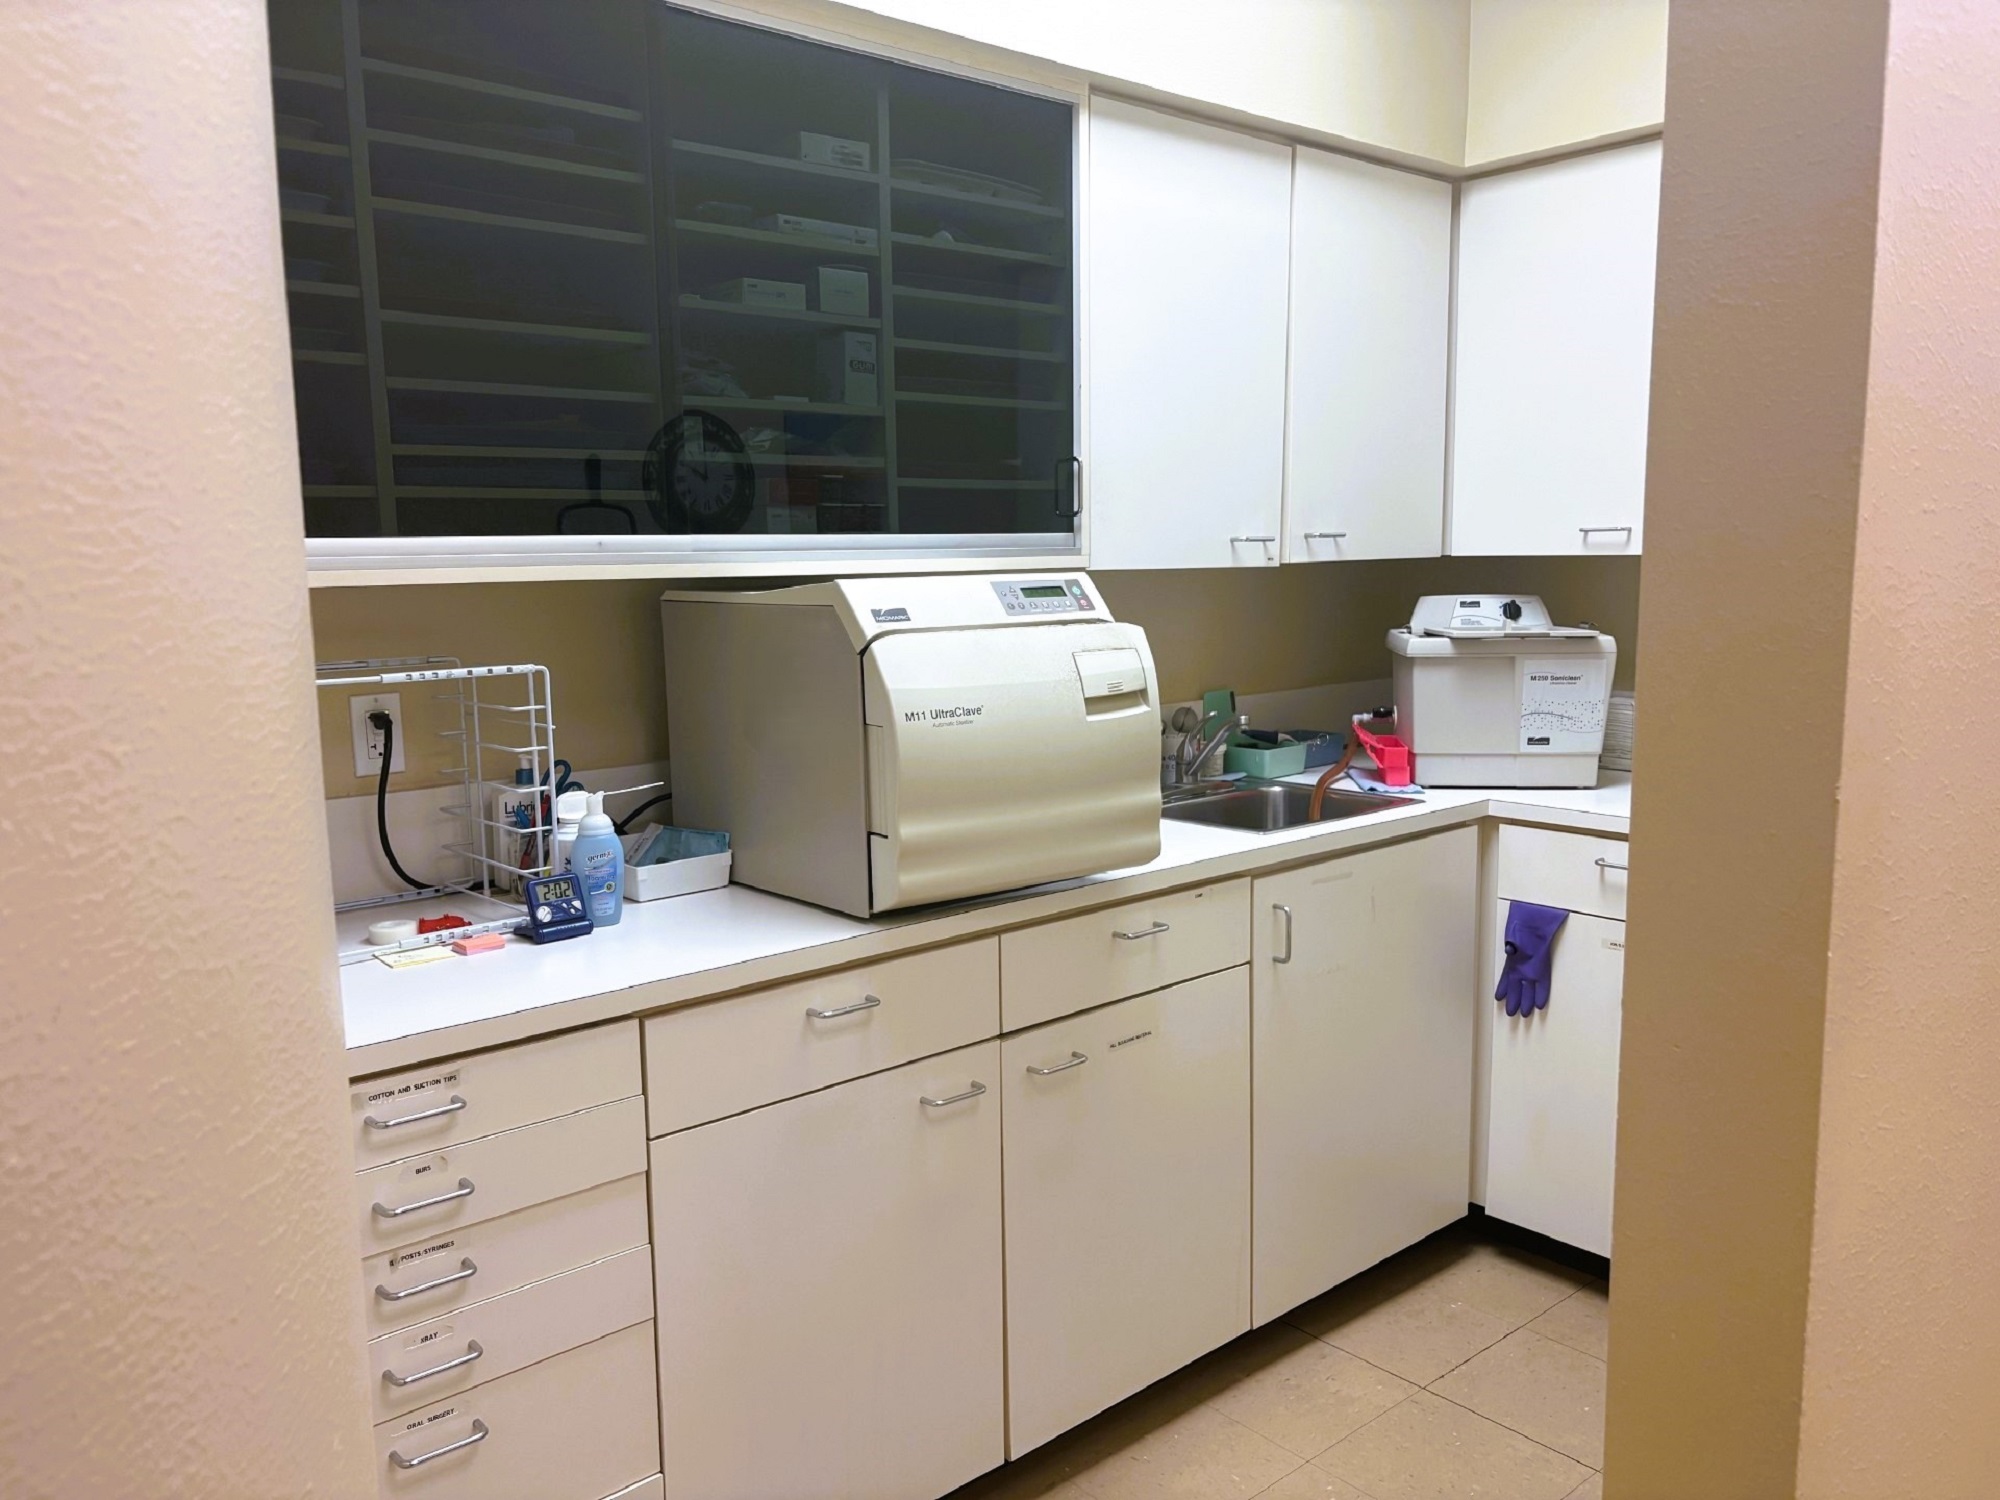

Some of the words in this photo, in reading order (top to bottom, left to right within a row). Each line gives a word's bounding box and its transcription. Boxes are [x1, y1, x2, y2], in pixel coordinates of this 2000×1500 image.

[905, 711, 927, 722] M11
[930, 706, 982, 721] UltraClave
[543, 881, 571, 901] 2:02
[368, 1089, 395, 1102] COTTON
[397, 1085, 411, 1095] AND
[414, 1078, 442, 1091] SUCTION
[443, 1075, 457, 1083] TIPS
[415, 1165, 432, 1175] BURS
[406, 1420, 424, 1430] ORAL
[427, 1408, 455, 1423] SURGERY
